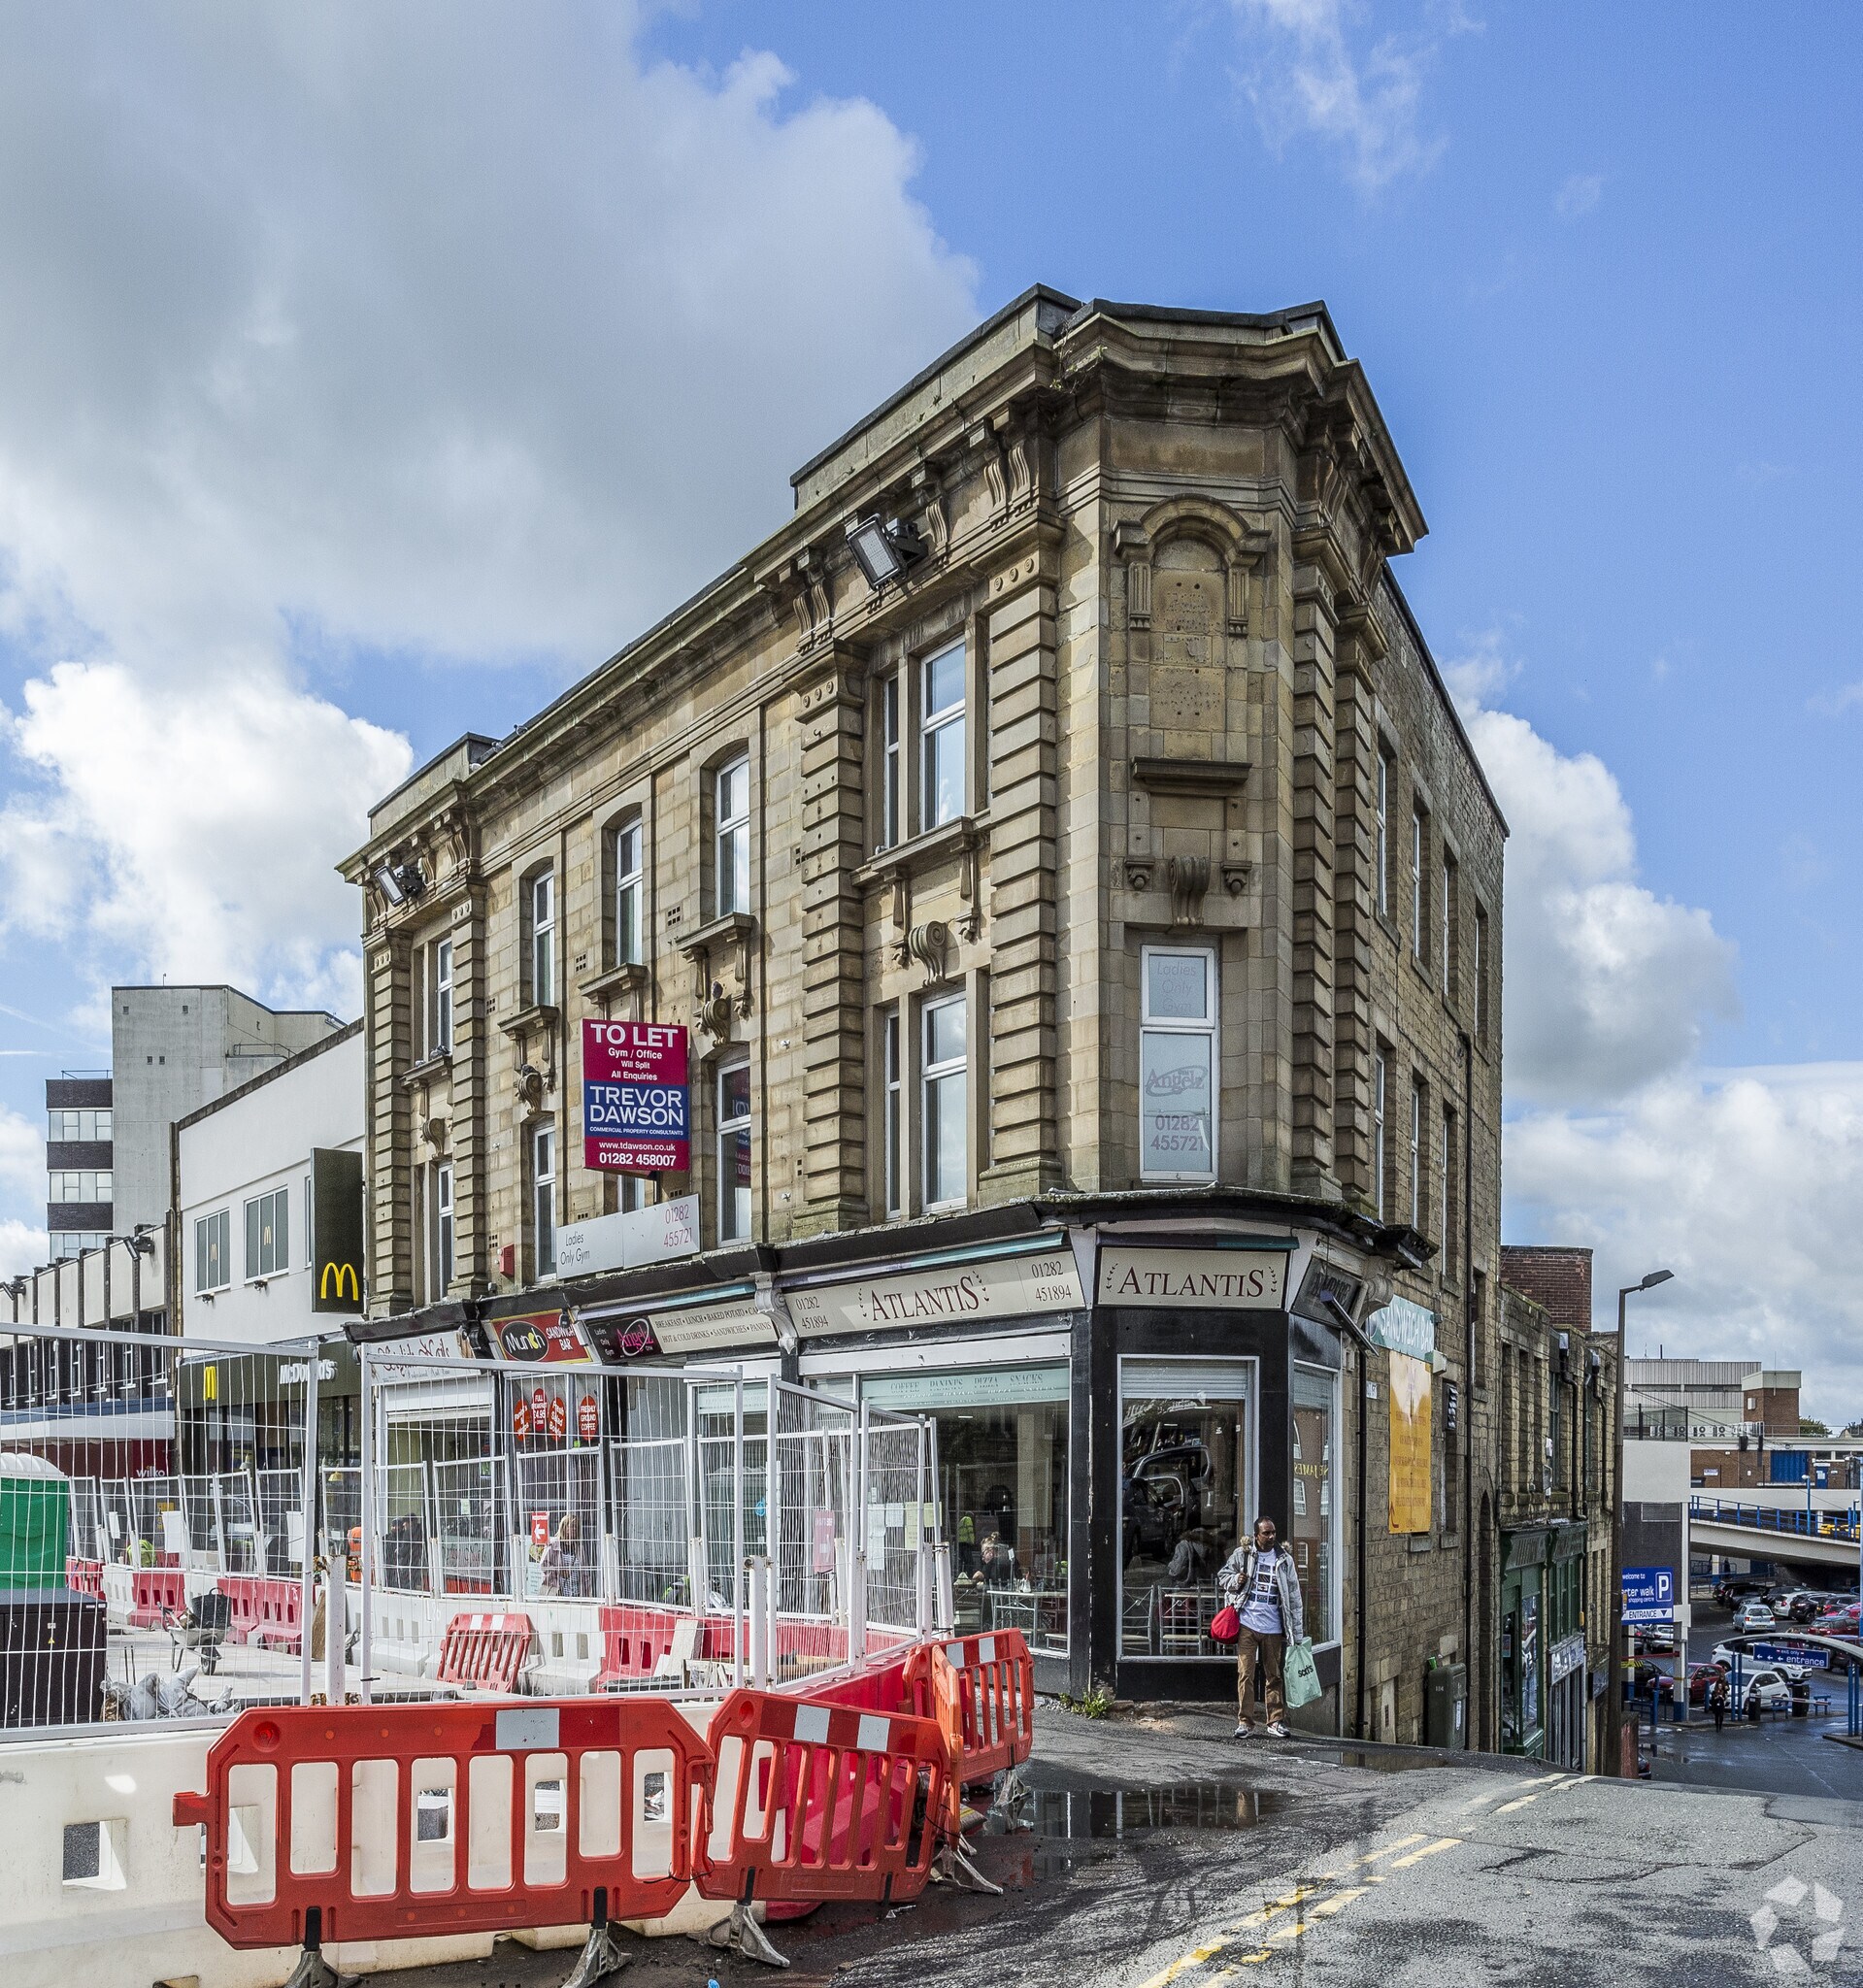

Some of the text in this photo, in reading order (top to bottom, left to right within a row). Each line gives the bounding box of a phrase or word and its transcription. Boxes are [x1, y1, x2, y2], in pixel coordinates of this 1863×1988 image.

[590, 1023, 679, 1048] TO LET
[608, 1047, 628, 1059] Gym
[636, 1049, 662, 1060] Office
[635, 1061, 650, 1070] Split
[623, 1071, 658, 1081] Enquiries
[589, 1085, 682, 1108] TREVOR
[590, 1105, 683, 1126] DAWSON
[1154, 1114, 1200, 1131] 01282
[599, 1142, 676, 1152] www.tdawson.co.uk
[1150, 1134, 1204, 1152] 455721
[599, 1152, 677, 1167] 01282 458007
[665, 1204, 689, 1224] 01282
[565, 1231, 584, 1246] Ladies
[663, 1227, 692, 1248] 455721
[560, 1247, 590, 1266] Only Gym
[1030, 1260, 1064, 1279] 01282
[1117, 1266, 1265, 1298] ATLANTIS
[871, 1275, 981, 1322] ATLANTIS
[1035, 1283, 1073, 1302] 451894
[795, 1296, 819, 1311] 01282
[655, 1318, 682, 1329] BREAKFAST
[684, 1314, 704, 1325] LUNCH
[706, 1311, 725, 1322] BAKED
[724, 1309, 746, 1319] POTATO
[801, 1314, 829, 1330] 451894
[506, 1327, 546, 1354] Munch
[546, 1323, 576, 1340] SANDWICH
[615, 1324, 654, 1352] Angelz
[662, 1334, 673, 1343] HOT
[673, 1334, 678, 1342] &
[677, 1331, 692, 1342] COLD
[690, 1329, 711, 1341] DRINKS
[712, 1324, 748, 1337] SANDWICHES
[558, 1338, 574, 1351] BAR
[136, 1465, 165, 1477] wilko
[1640, 1585, 1654, 1597] walk
[1658, 1574, 1670, 1599] P
[1628, 1609, 1657, 1619] ENTRANCE
[1786, 1655, 1825, 1667] entrance
